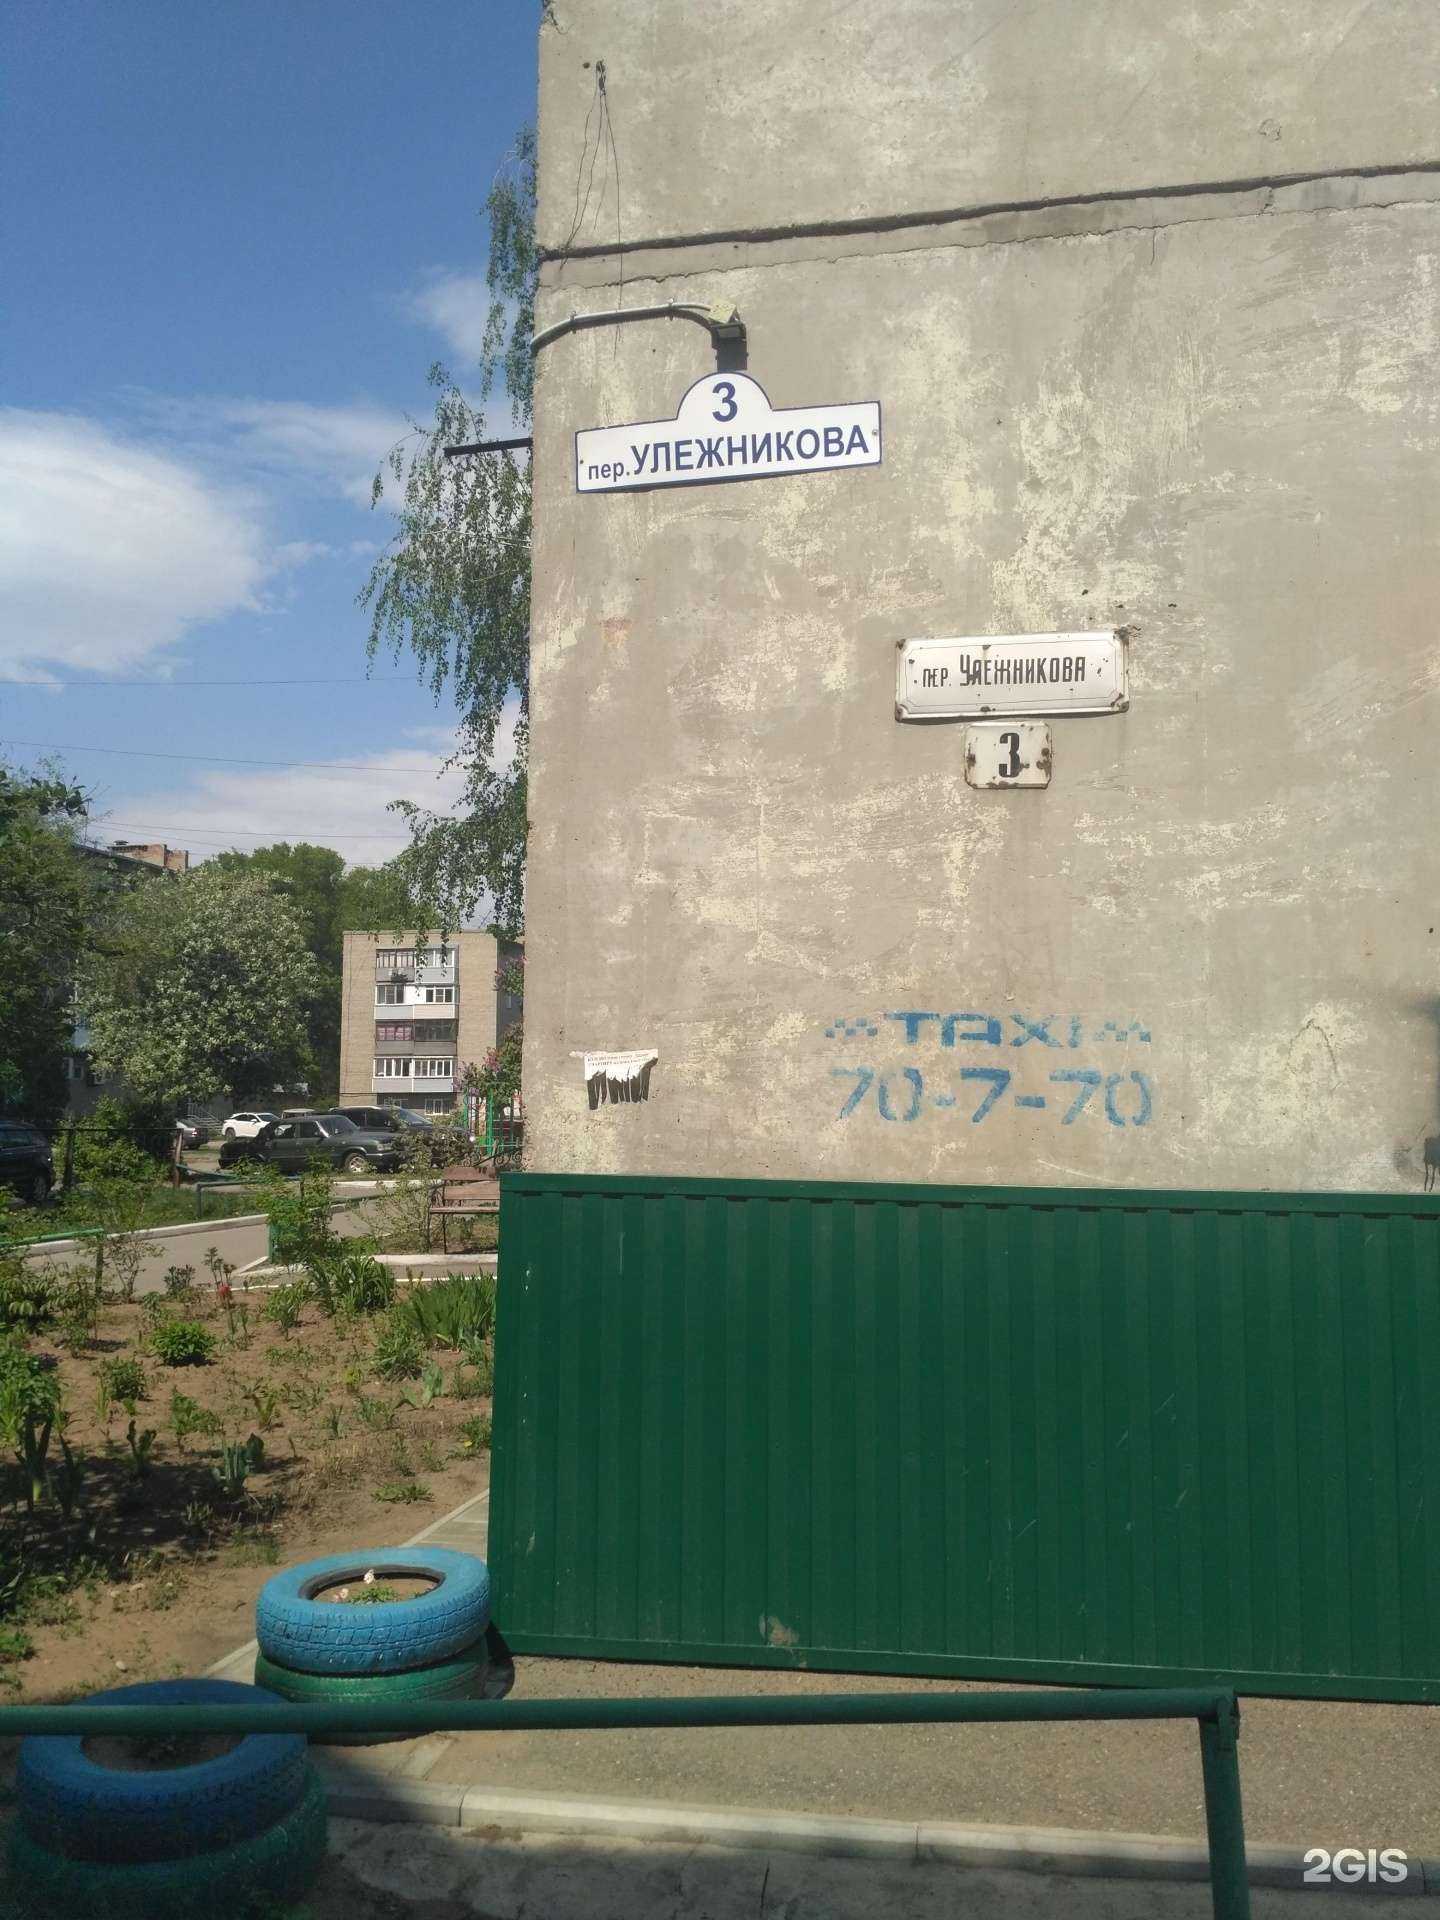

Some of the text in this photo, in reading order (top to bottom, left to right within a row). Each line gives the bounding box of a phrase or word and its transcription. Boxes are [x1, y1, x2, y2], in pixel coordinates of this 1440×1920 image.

[712, 382, 738, 422] 3
[588, 424, 869, 482] пер. УЛЕЖНИКОВА
[998, 732, 1021, 778] 3
[831, 1067, 1152, 1127] 70-7-70
